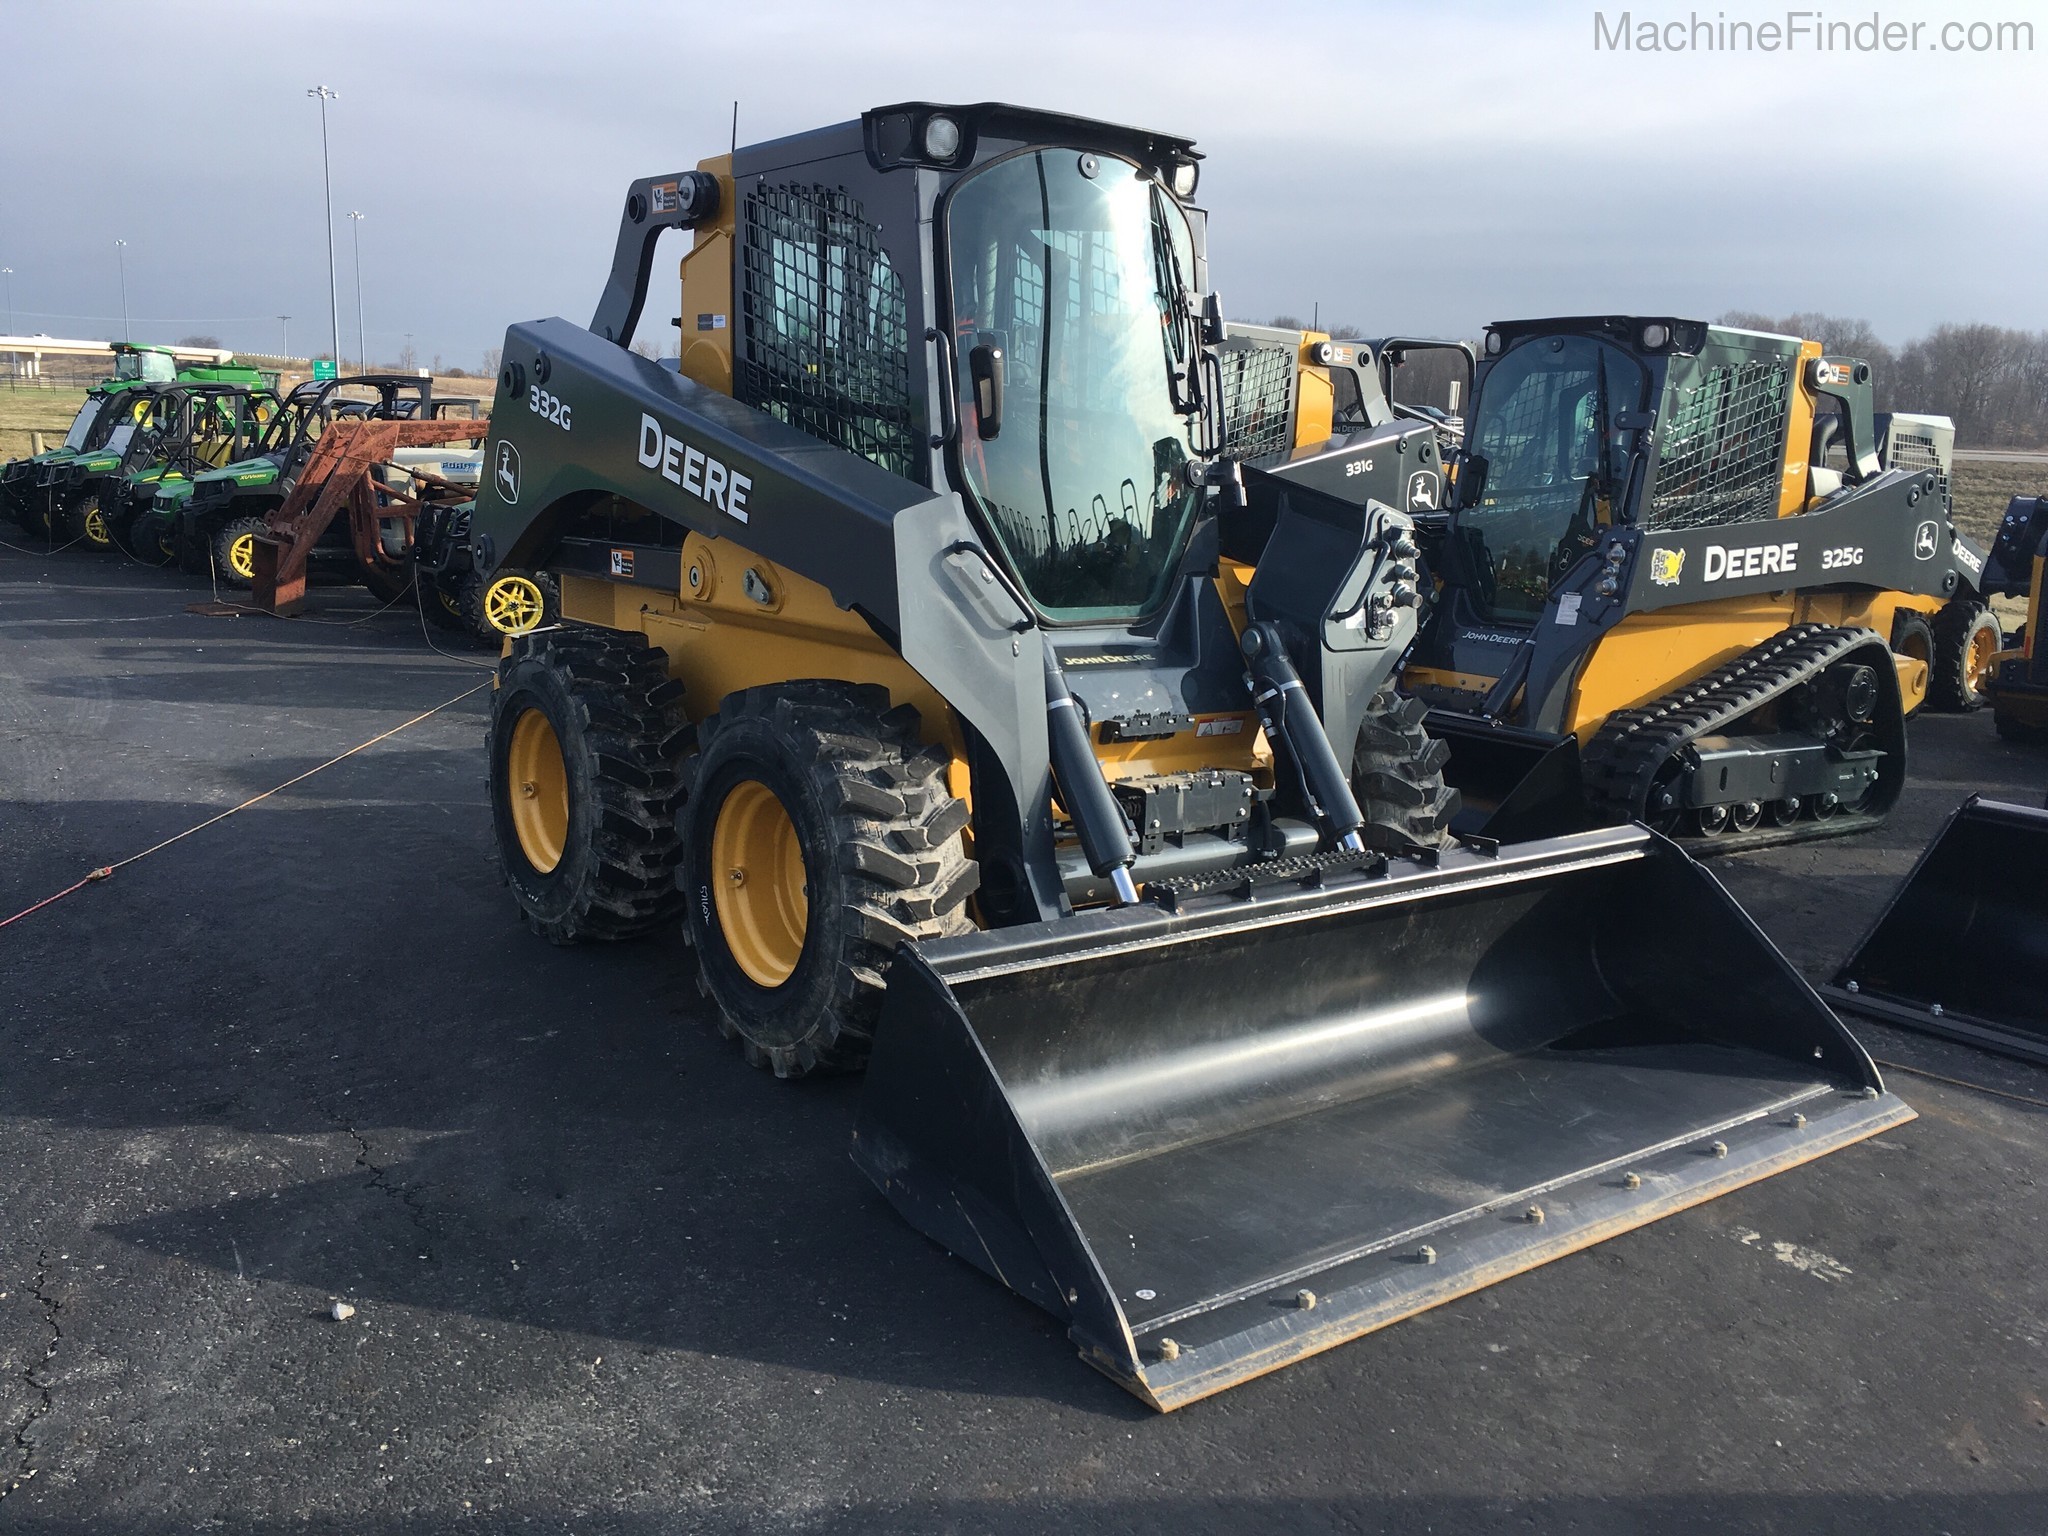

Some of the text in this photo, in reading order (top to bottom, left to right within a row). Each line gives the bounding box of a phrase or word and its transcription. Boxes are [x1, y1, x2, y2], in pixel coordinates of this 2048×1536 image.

[530, 385, 572, 431] 332G
[638, 413, 752, 524] DEERE
[1345, 460, 1373, 477] 331G
[1704, 542, 1799, 582] DEERE
[1822, 547, 1863, 570] 325G
[1953, 538, 1981, 573] DEERE
[1653, 565, 1668, 577] Pro
[1462, 631, 1489, 641] JOHN
[1064, 654, 1156, 665] JOHN DEERE
